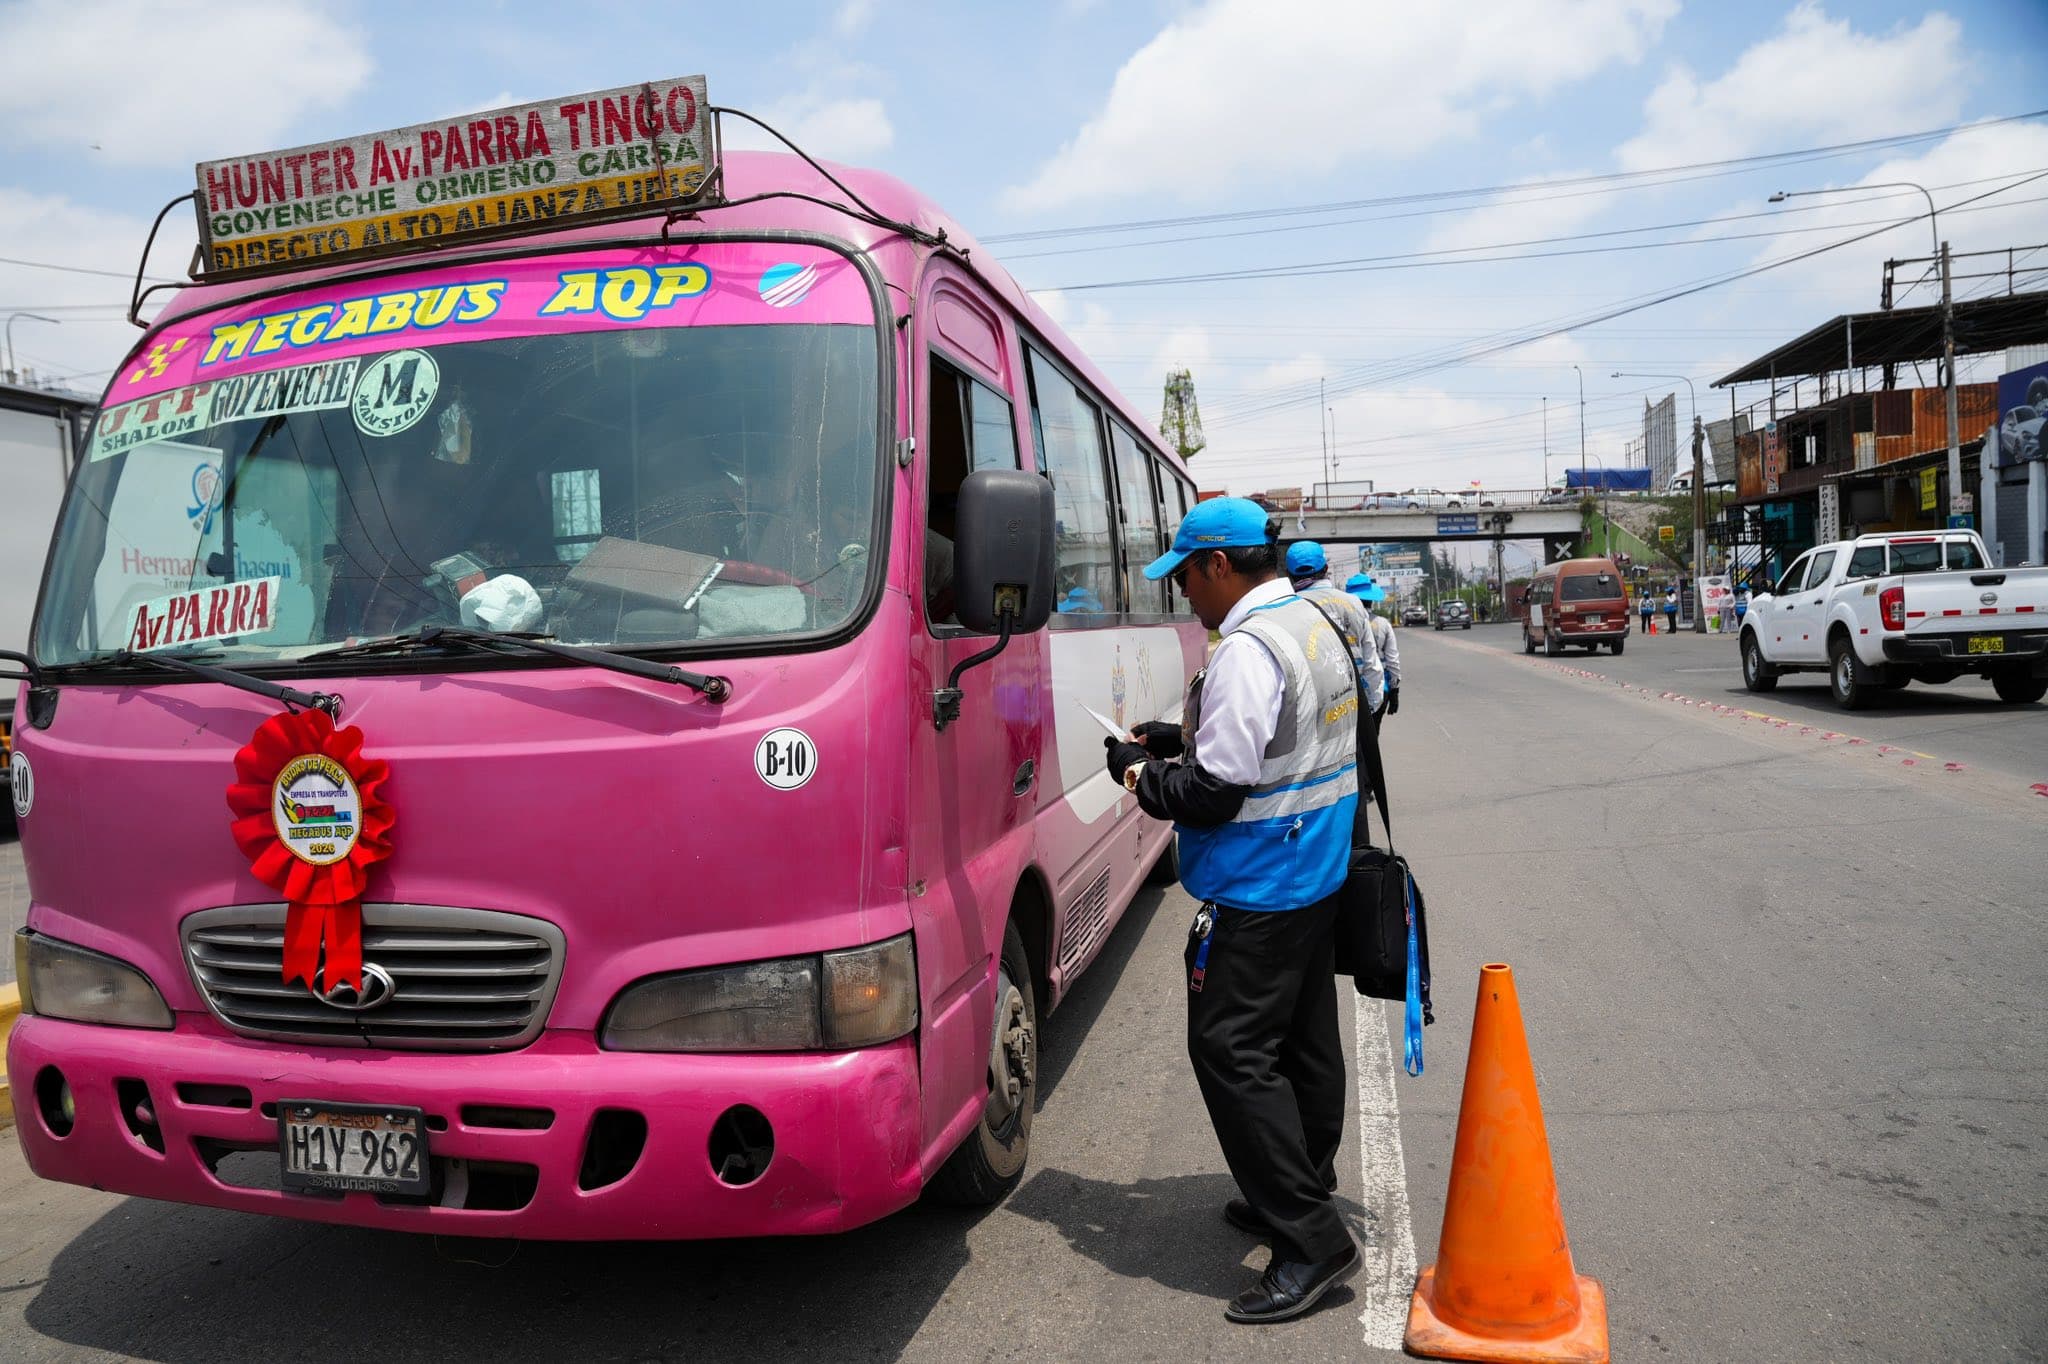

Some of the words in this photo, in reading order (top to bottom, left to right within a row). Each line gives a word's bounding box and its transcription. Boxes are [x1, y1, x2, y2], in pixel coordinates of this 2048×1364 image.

[207, 146, 358, 212] HUNTER
[560, 85, 697, 150] TINGO
[211, 187, 397, 236] GOYENECHE
[578, 138, 698, 176] CARSA
[214, 228, 350, 271] DIRECTO
[362, 212, 443, 248] ALTO
[455, 185, 606, 231] ALIANZA
[201, 280, 507, 366] MEGABUS
[538, 263, 710, 321] AQP
[210, 360, 358, 423] GOYENECHE
[359, 387, 429, 429] MANSION
[373, 357, 420, 409] M
[98, 384, 213, 437] UTP
[102, 415, 198, 453] SHALOM
[766, 741, 806, 776] B-10
[288, 826, 332, 839] MEGABUS
[335, 825, 354, 840] AQP
[309, 843, 336, 856] 2026
[324, 1175, 380, 1192] HYUNDAI
